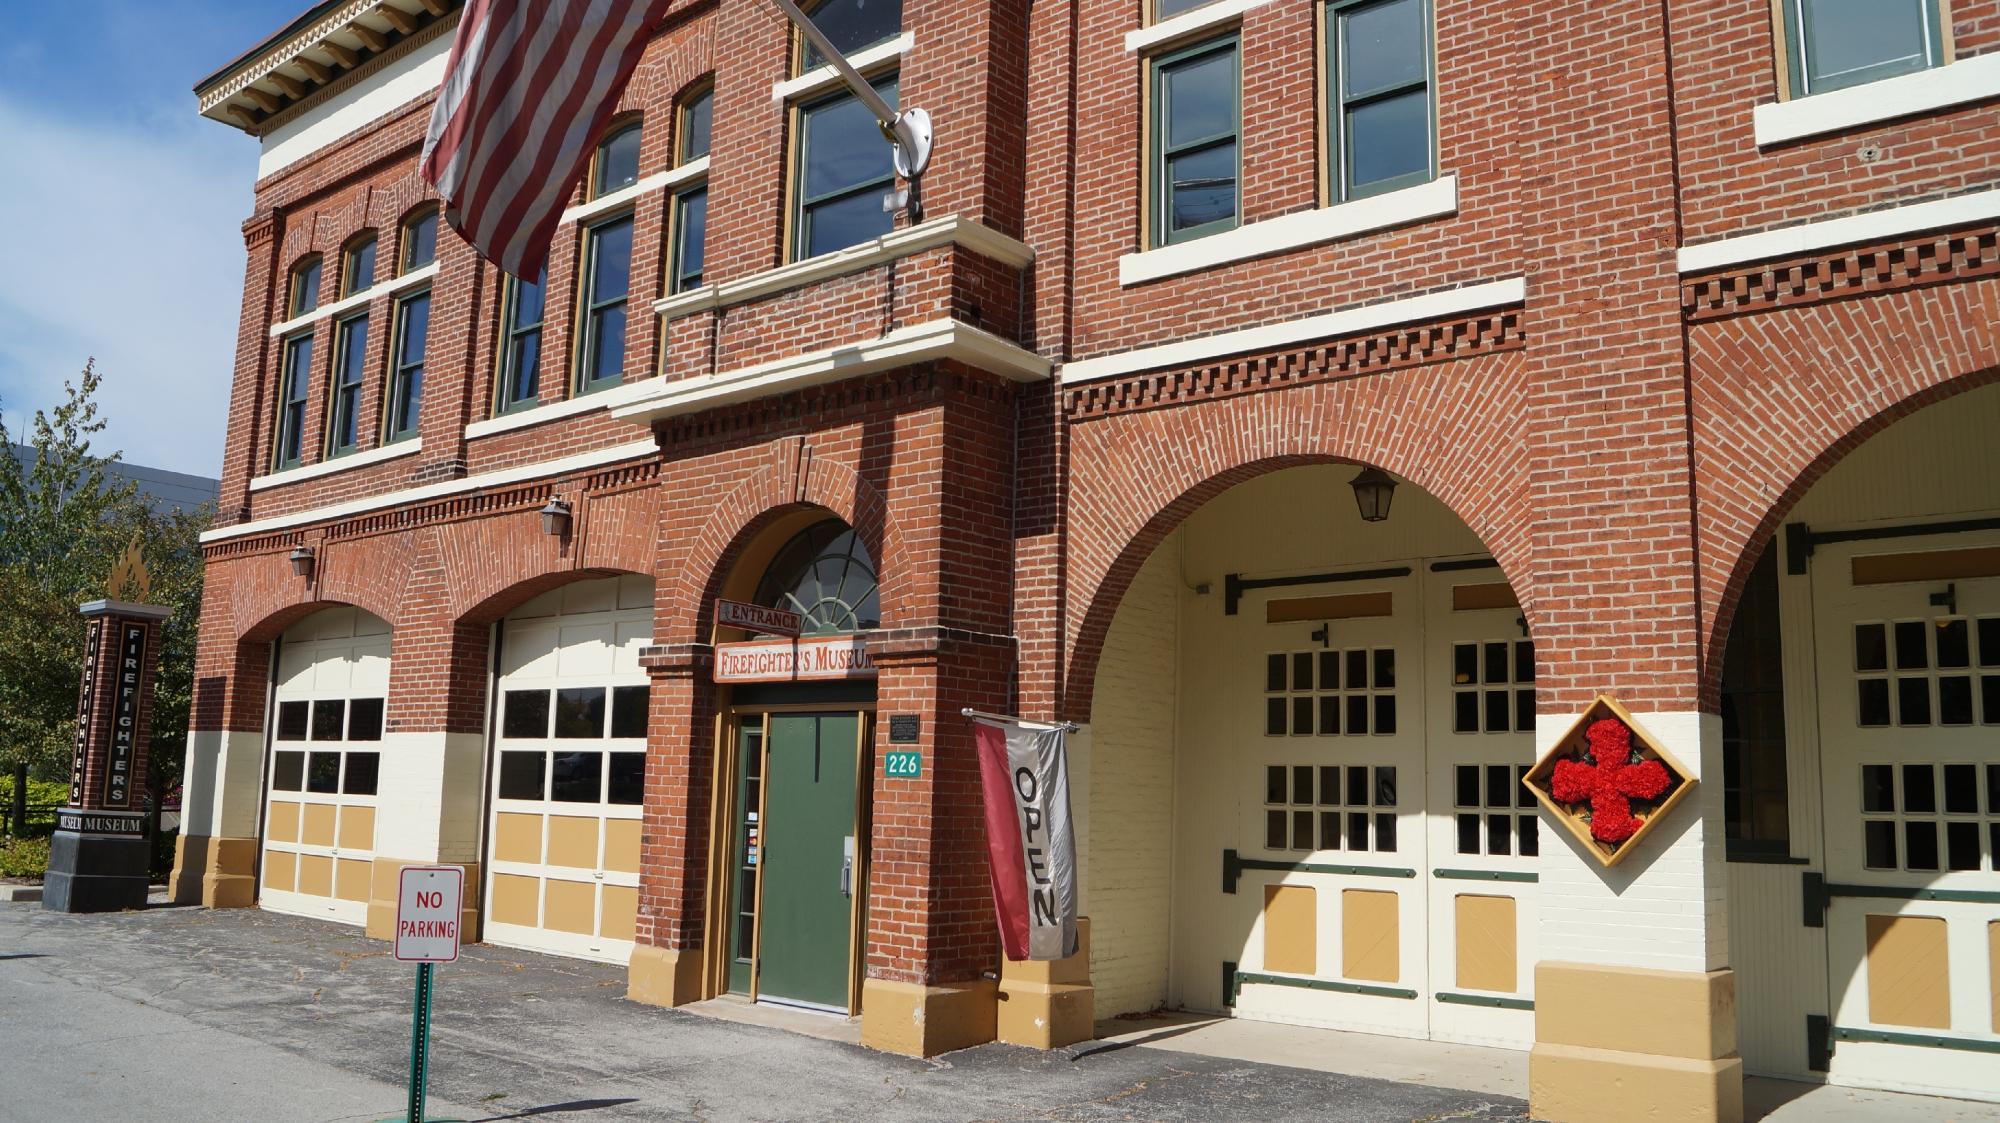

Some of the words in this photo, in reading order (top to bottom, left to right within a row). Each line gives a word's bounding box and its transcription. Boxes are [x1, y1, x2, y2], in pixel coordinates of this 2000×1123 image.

[731, 605, 799, 629] ENTRANCE
[720, 650, 811, 676] FIREFIGHTER'S
[815, 646, 875, 672] MUSEUM
[72, 627, 97, 798] FIREFIGHTERS
[112, 629, 140, 801] FIREFIGHTERS
[889, 755, 917, 773] 226
[84, 817, 141, 832] MUSEUM
[1015, 766, 1058, 927] OPEN
[416, 891, 442, 908] NO
[400, 920, 454, 938] PARKING
